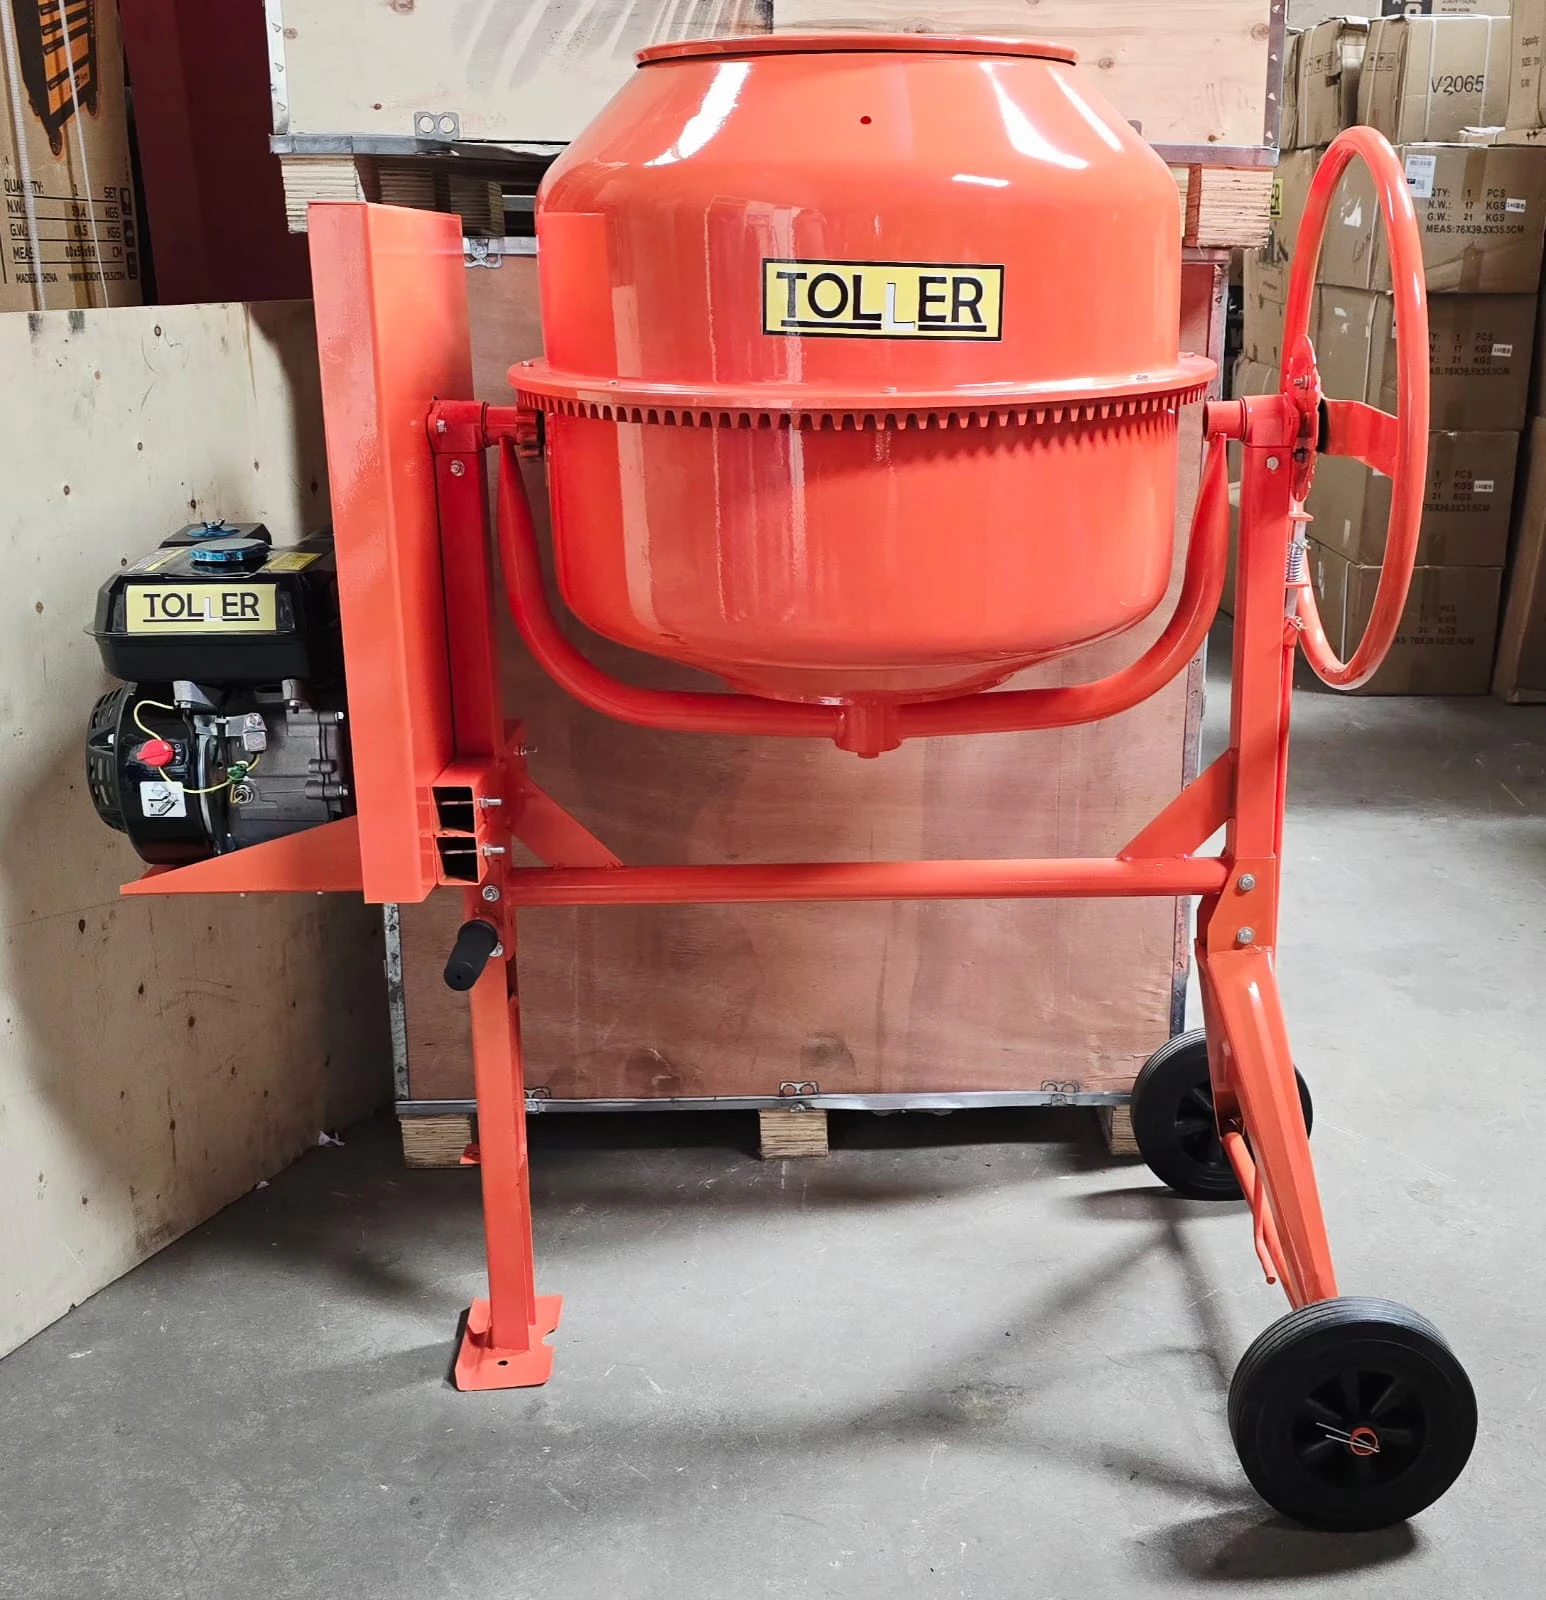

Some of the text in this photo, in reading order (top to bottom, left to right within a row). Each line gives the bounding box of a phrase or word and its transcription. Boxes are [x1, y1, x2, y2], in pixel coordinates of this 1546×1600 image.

[1431, 75, 1485, 94] V2065
[1467, 189, 1471, 197] 1
[1487, 189, 1506, 198] PCS
[1428, 201, 1452, 209] N.W.:
[1486, 201, 1505, 210] KGS
[1427, 213, 1505, 222] G.W.: 21 KGS
[776, 271, 983, 330] TOLLER
[1475, 332, 1493, 341] PCS
[143, 592, 260, 622] TOLLER
